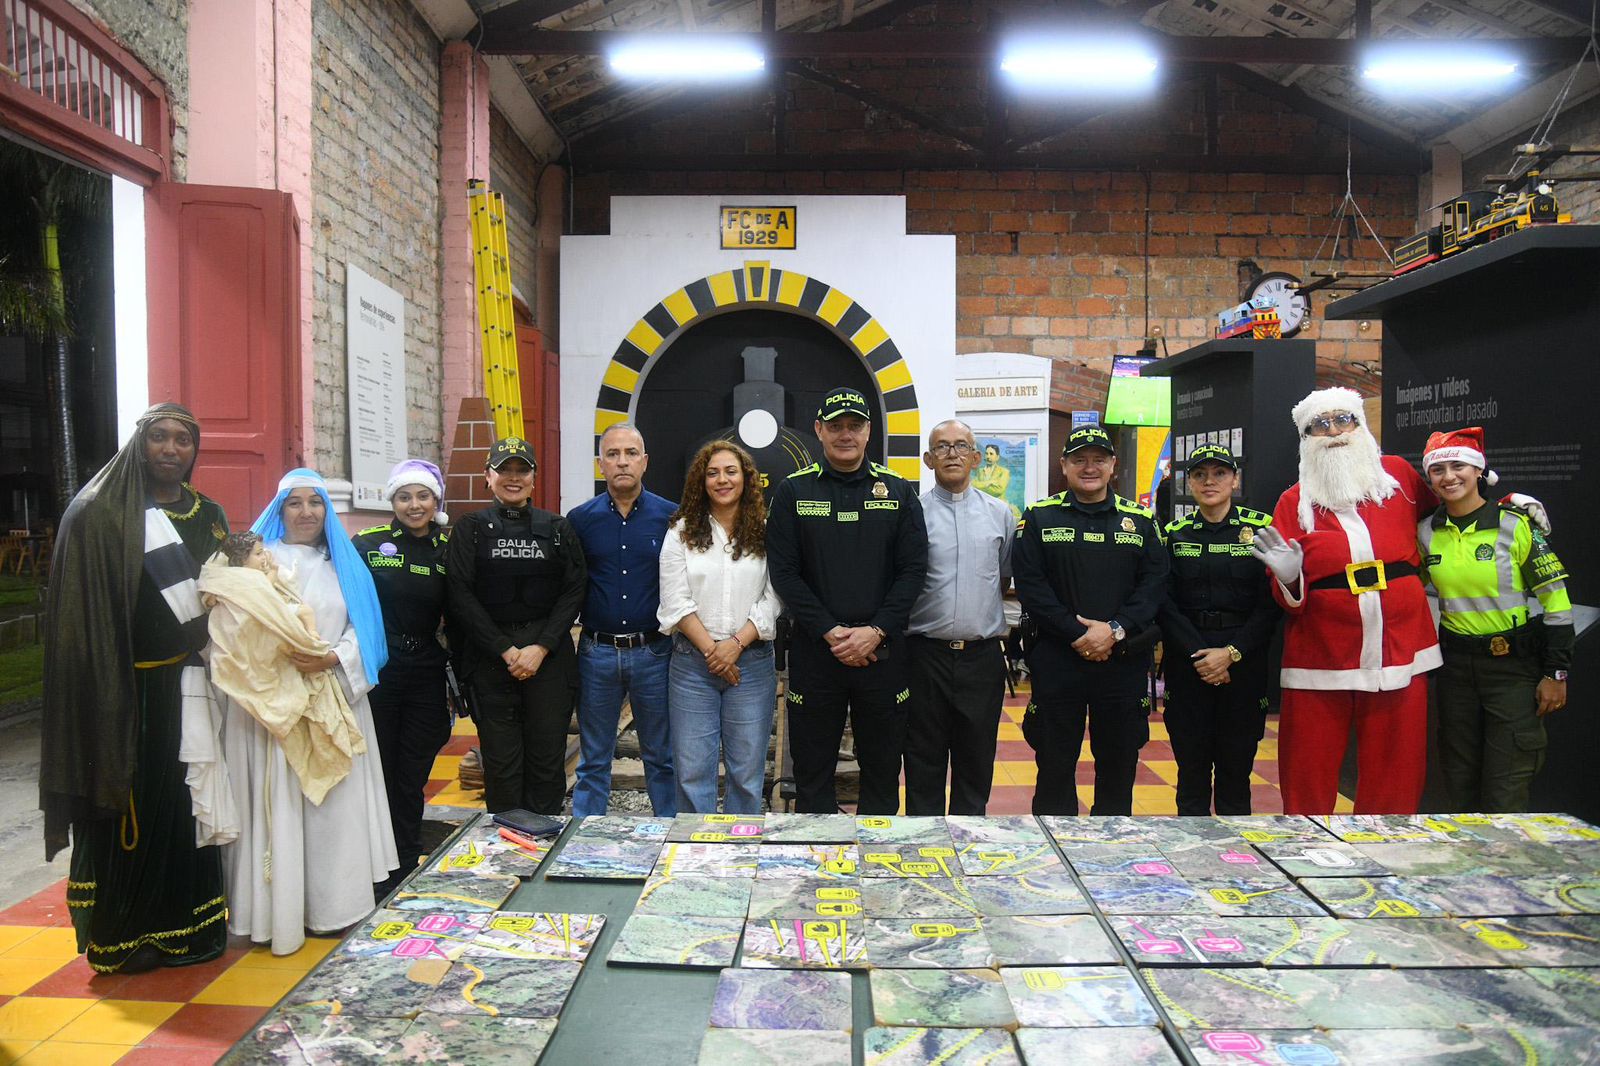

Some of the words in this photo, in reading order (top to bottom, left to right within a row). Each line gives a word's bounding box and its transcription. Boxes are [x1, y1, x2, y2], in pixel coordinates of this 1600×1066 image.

[727, 210, 751, 229] FC
[755, 213, 772, 224] DE
[775, 210, 789, 229] A
[739, 230, 778, 245] 1929
[957, 386, 996, 398] GALERIA
[999, 386, 1012, 397] DE
[1014, 385, 1038, 397] ARTE
[1396, 380, 1433, 407] Imágenes
[1434, 383, 1440, 404] y
[1441, 376, 1471, 398] videos
[825, 393, 865, 406] POLICÍA
[1396, 411, 1409, 432] que
[1410, 402, 1454, 429] transportan
[1456, 400, 1465, 421] al
[1466, 395, 1498, 425] pasado
[498, 444, 527, 452] GAULA
[1191, 445, 1230, 458] POLICÍA
[1430, 450, 1460, 461] Navidad
[497, 538, 539, 548] GAULA
[491, 547, 545, 559] POLICÍA
